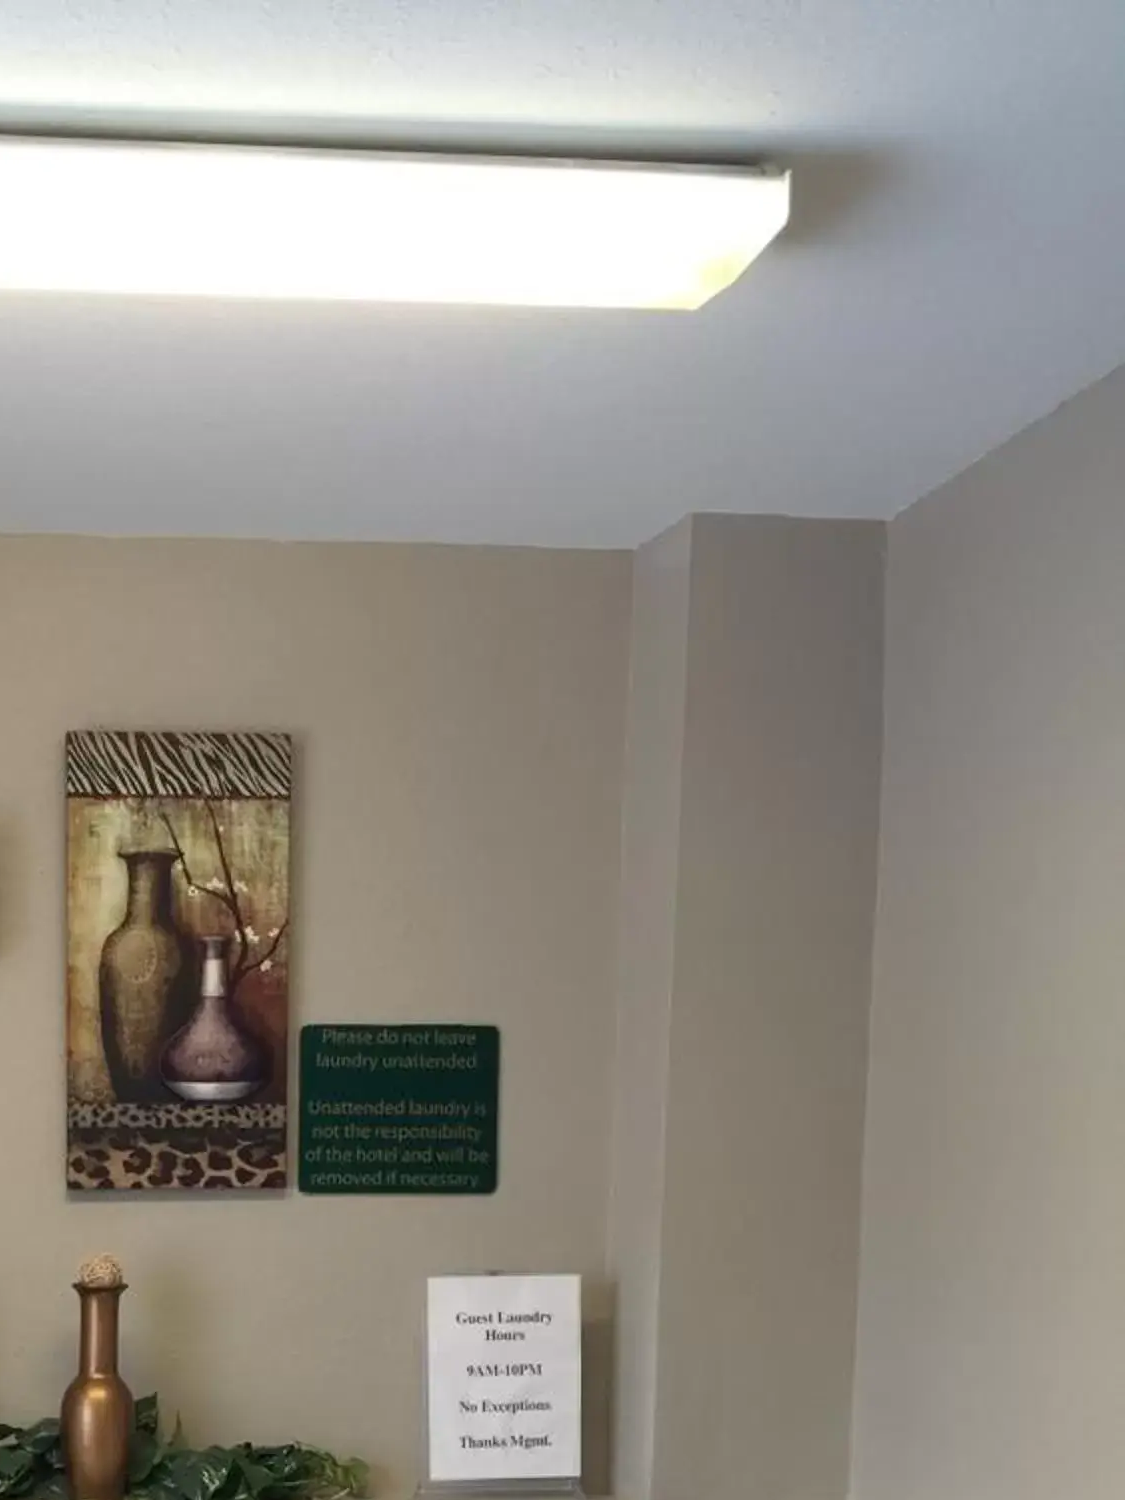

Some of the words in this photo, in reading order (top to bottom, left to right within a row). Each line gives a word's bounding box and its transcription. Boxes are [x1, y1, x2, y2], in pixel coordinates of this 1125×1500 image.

[321, 1029, 374, 1045] Please
[377, 1028, 399, 1045] do
[402, 1030, 429, 1045] not
[434, 1029, 477, 1045] leave
[315, 1054, 378, 1071] laundry
[382, 1053, 478, 1070] unattended
[307, 1100, 406, 1116] Unattended
[408, 1101, 471, 1119] laundry
[474, 1101, 487, 1116] is
[311, 1126, 340, 1139] not
[344, 1123, 372, 1139] the
[375, 1123, 483, 1143] responsibility
[304, 1147, 323, 1163] of
[326, 1147, 352, 1163] the
[356, 1147, 399, 1163] hotel
[401, 1147, 433, 1163] and
[436, 1147, 465, 1163] will
[468, 1148, 490, 1165] be
[310, 1169, 382, 1186] removed
[386, 1169, 398, 1185] if
[455, 1311, 494, 1325] Guest
[497, 1310, 553, 1326] Laundry
[484, 1328, 526, 1341] Hours
[466, 1363, 543, 1377] 9AM-10PM
[459, 1400, 478, 1413] No
[481, 1399, 552, 1415] Exceptions
[459, 1435, 509, 1449] Thanks
[510, 1434, 553, 1450] Mgmt.
